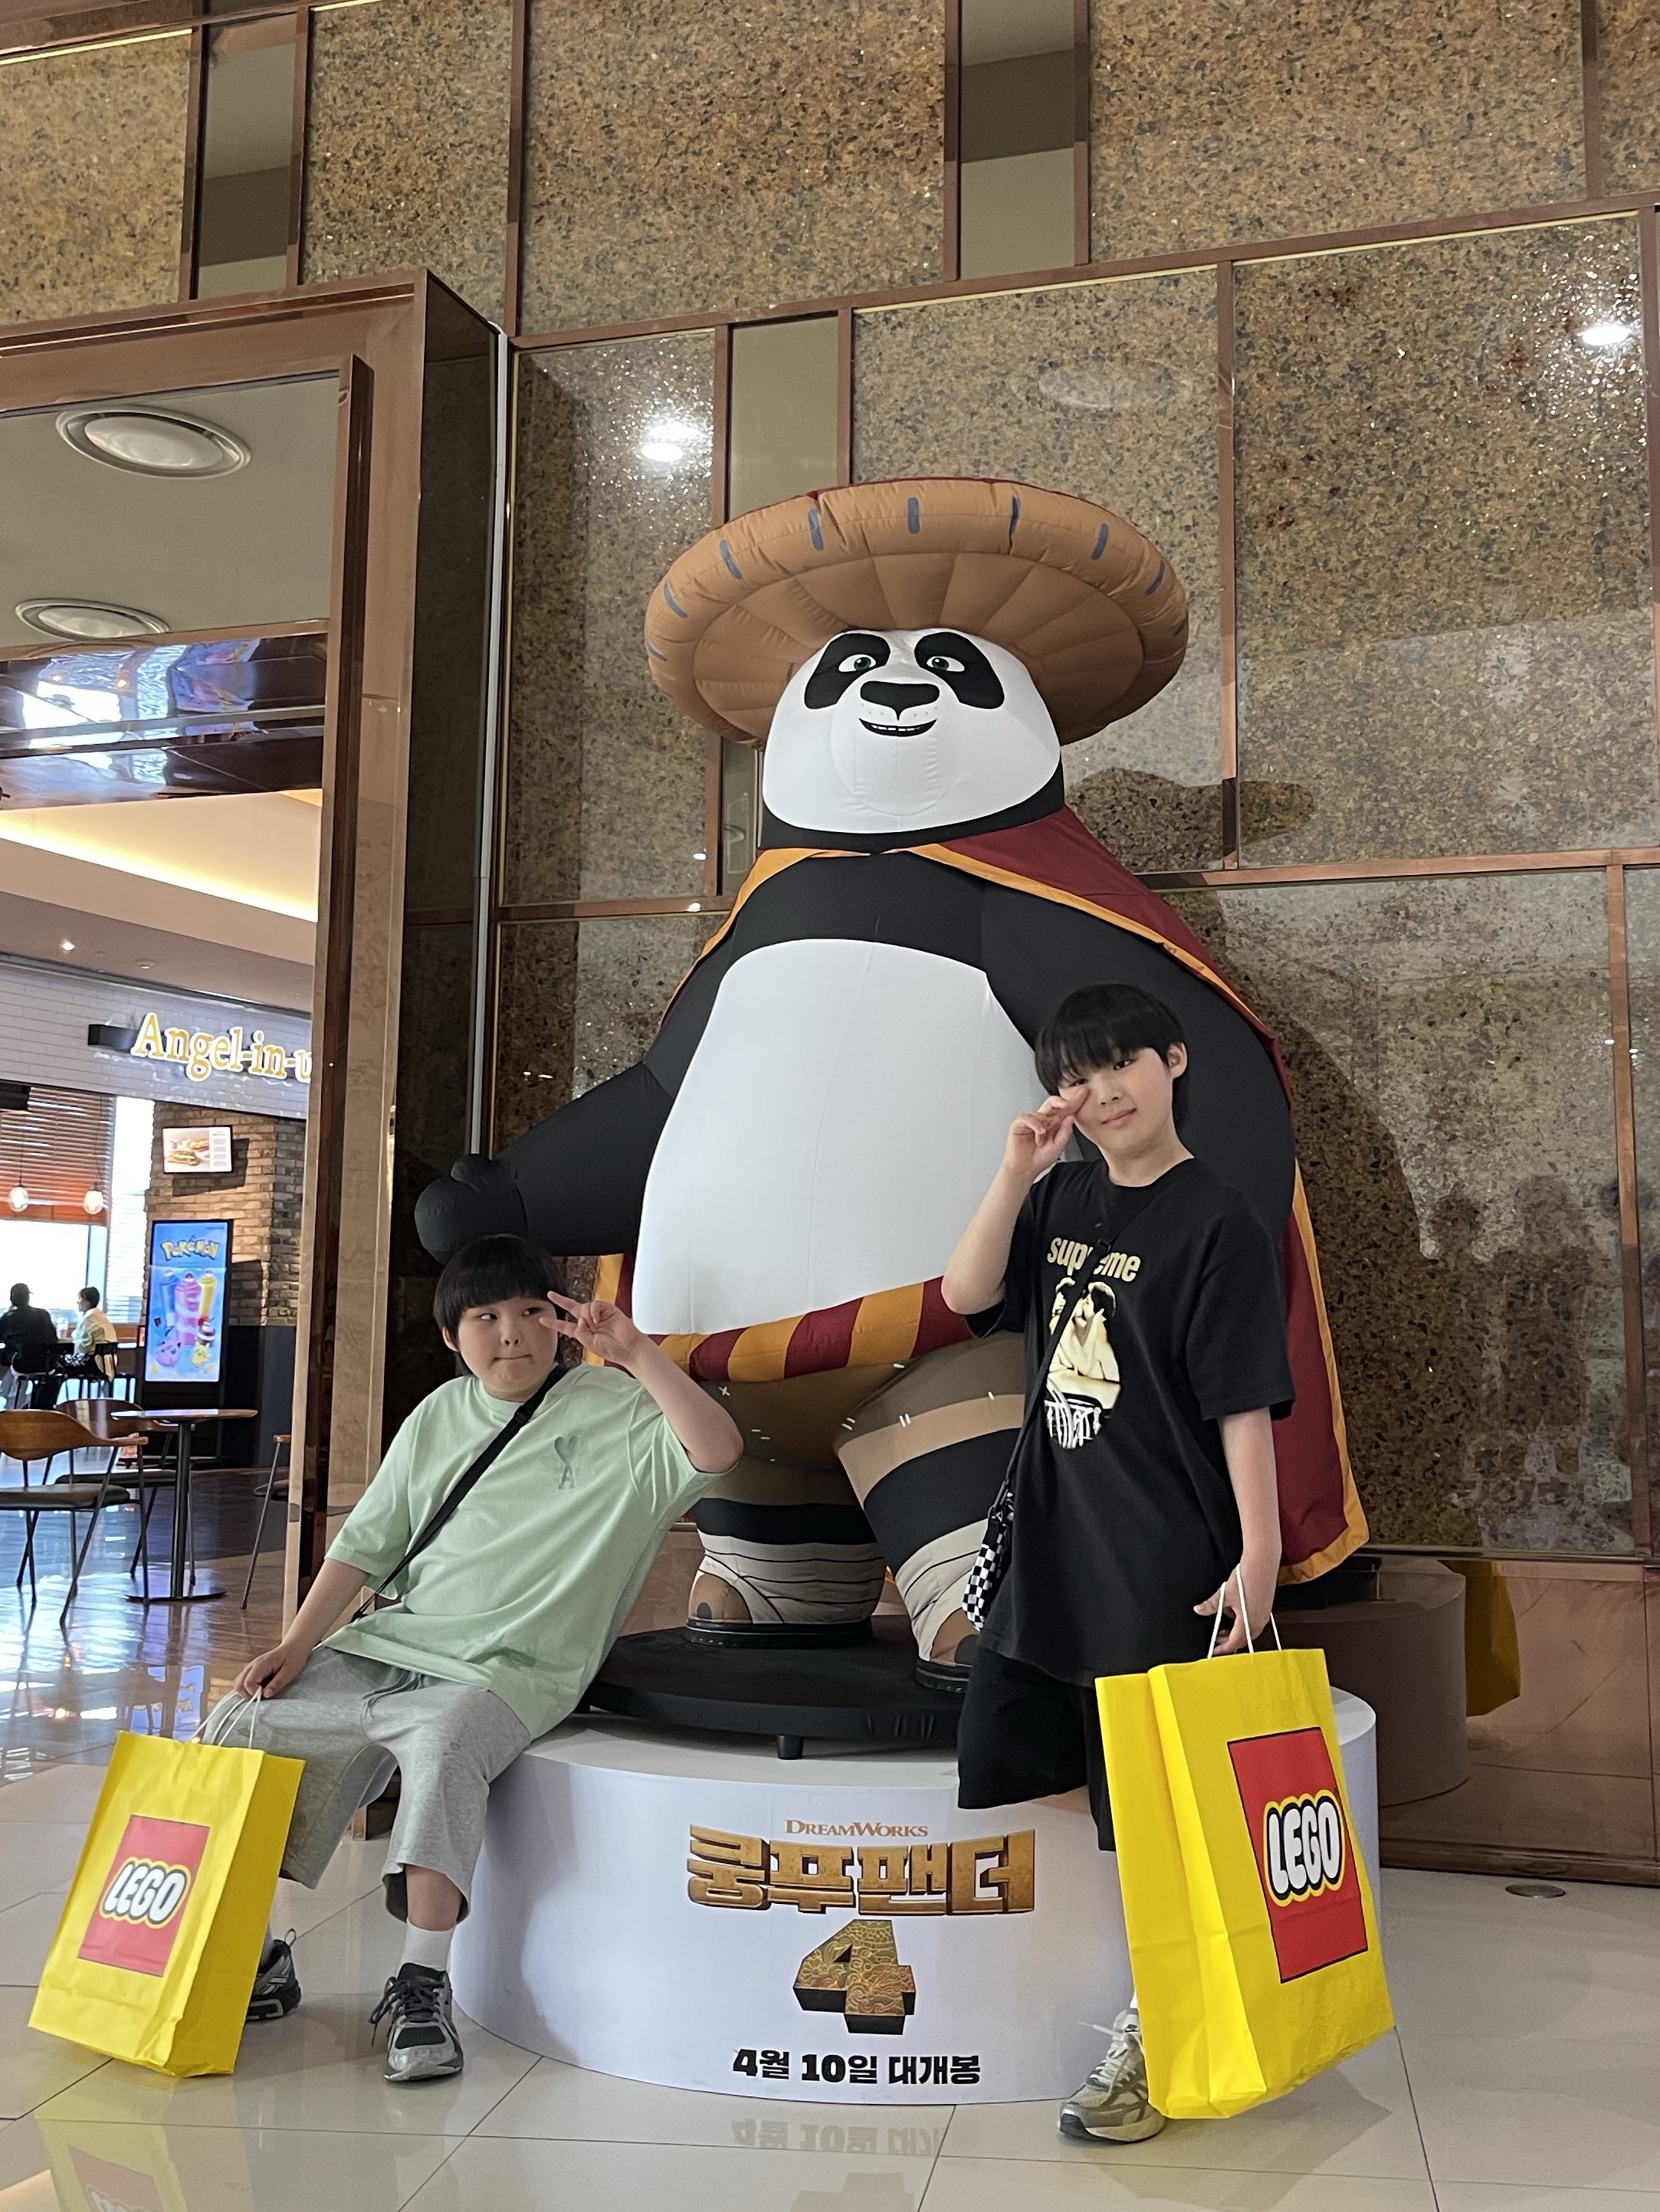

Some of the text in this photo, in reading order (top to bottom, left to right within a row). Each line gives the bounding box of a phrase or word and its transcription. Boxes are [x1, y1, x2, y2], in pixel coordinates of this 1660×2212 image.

[1047, 1237, 1141, 1282] supme
[687, 1824, 1035, 1915] 쿵푸팬더
[1268, 1801, 1341, 1895] LEGO
[103, 1864, 186, 1922] LEGO
[792, 1919, 916, 2035] 4
[733, 2049, 981, 2085] 4월 10일 대개봉
